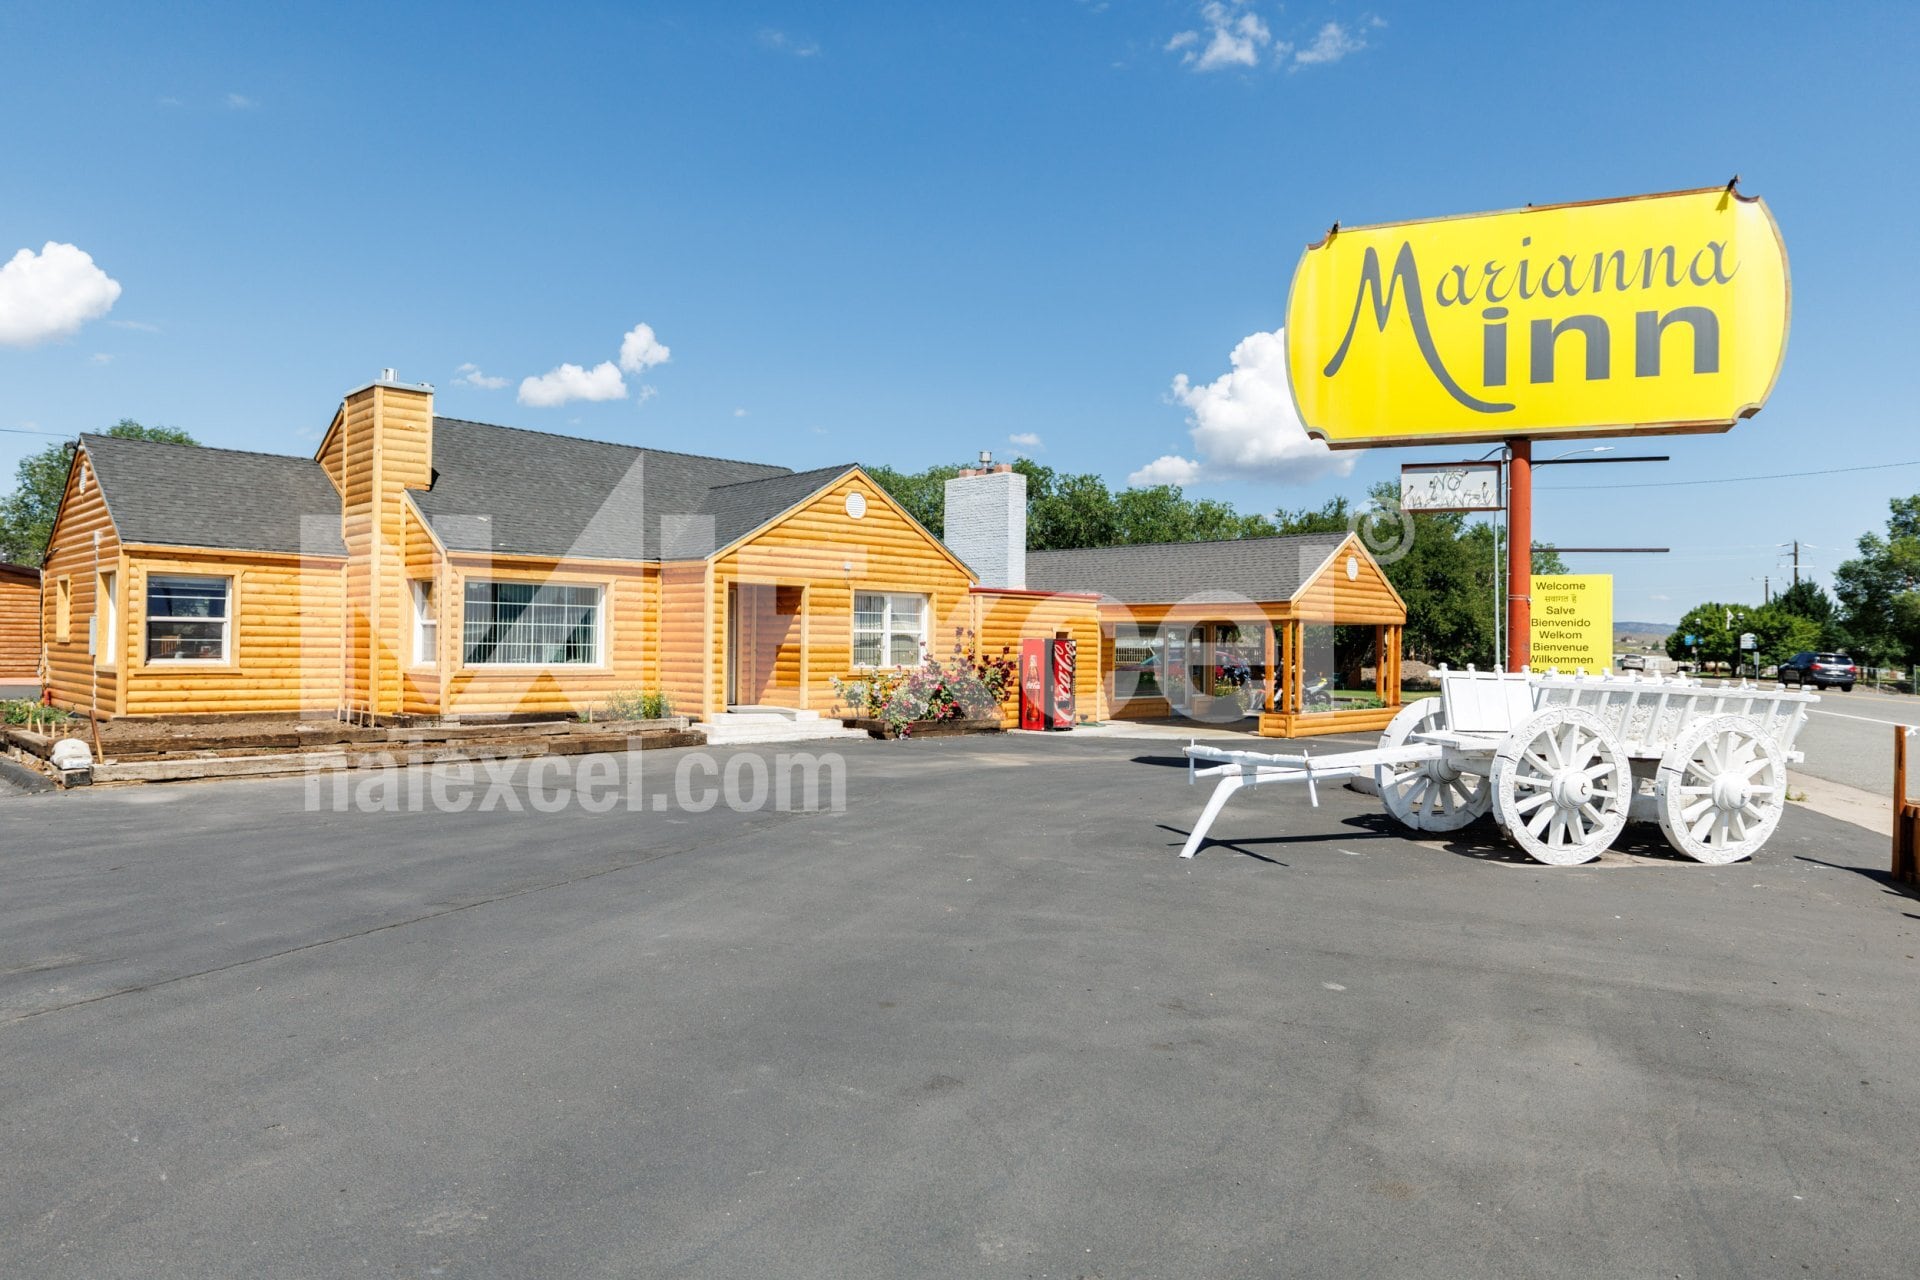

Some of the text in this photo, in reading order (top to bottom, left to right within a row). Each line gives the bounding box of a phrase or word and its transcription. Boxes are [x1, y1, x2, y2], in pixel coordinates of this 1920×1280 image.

[1324, 237, 1740, 413] Marianna
[1482, 306, 1719, 387] inn
[1536, 582, 1586, 590] Welcome
[1546, 606, 1576, 615] Salve
[1531, 618, 1591, 627] Bienvenido
[1539, 631, 1582, 639] Welkom
[1533, 642, 1589, 651] Bienvenue
